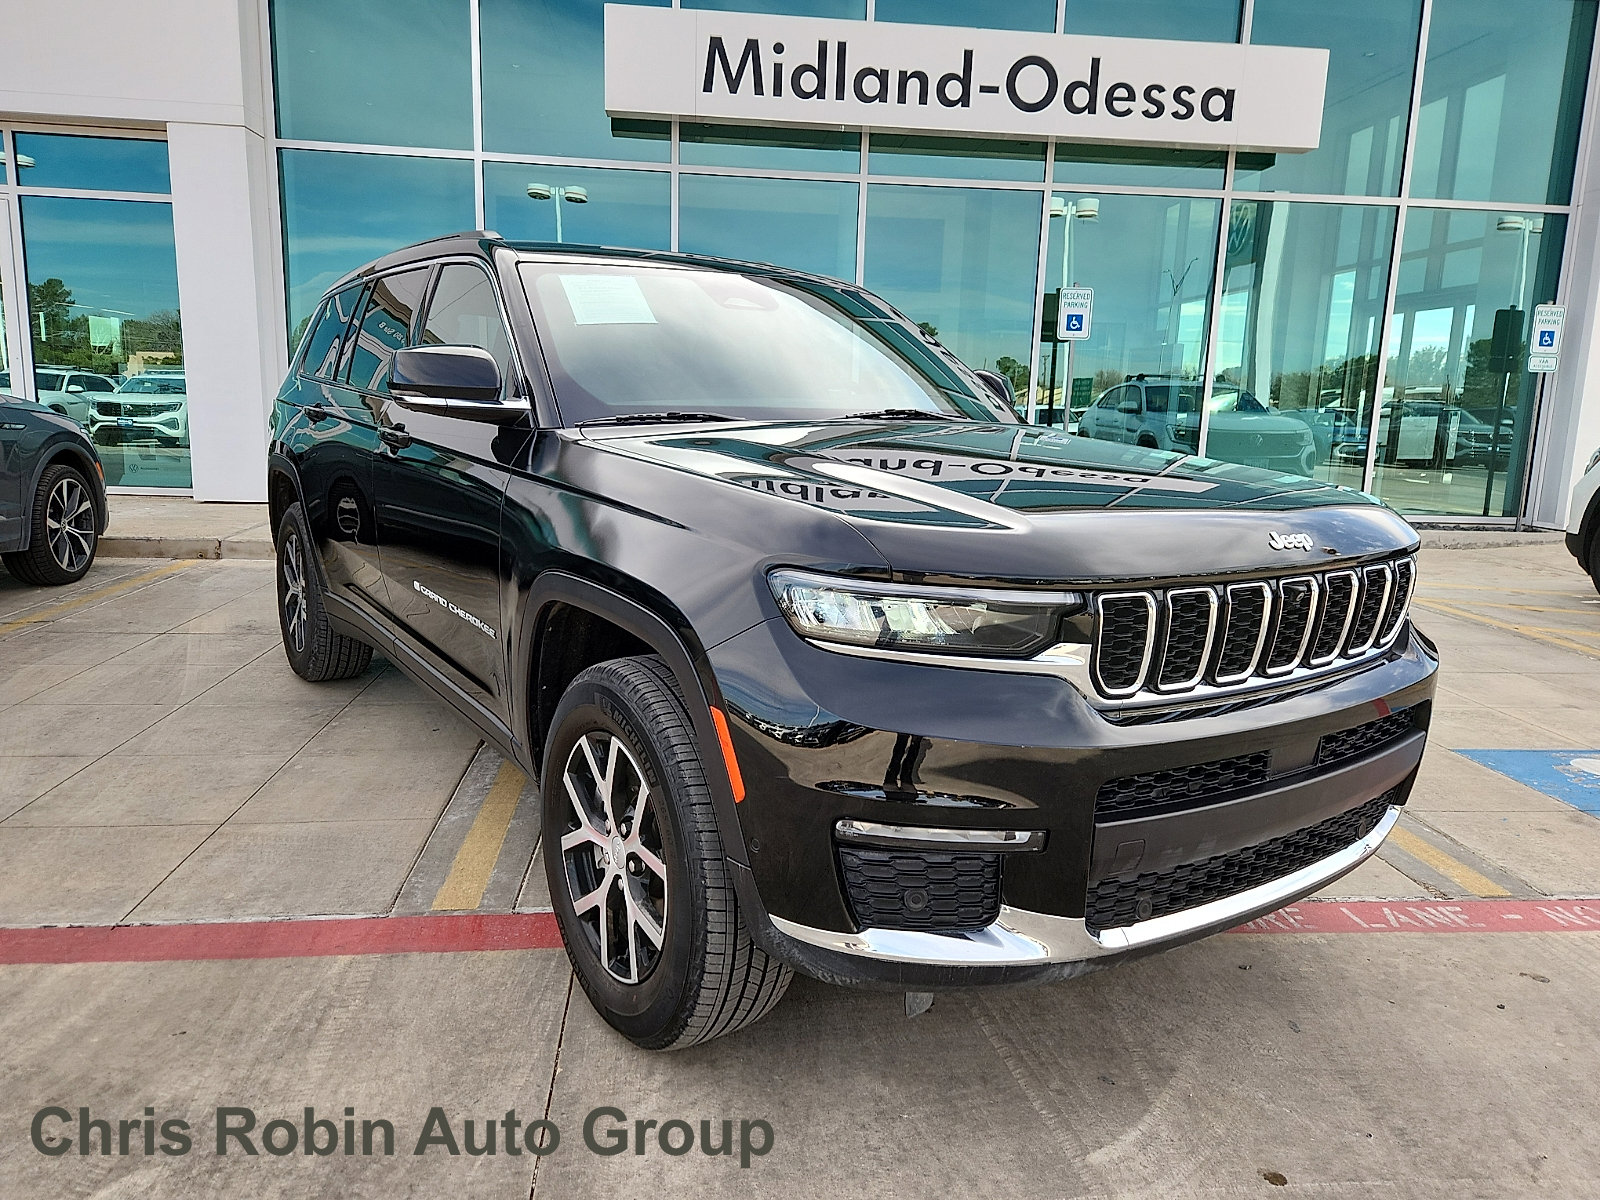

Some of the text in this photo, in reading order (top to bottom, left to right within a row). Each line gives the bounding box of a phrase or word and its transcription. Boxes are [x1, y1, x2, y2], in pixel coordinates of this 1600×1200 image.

[702, 35, 1237, 122] Midland-Odessa
[1062, 292, 1091, 300] RESERVED
[1063, 301, 1088, 309] PARKING
[1537, 309, 1563, 318] RESERVED
[1537, 318, 1560, 326] PARKING
[1268, 530, 1314, 552] Jeep
[420, 585, 496, 640] GRAND CHEROKEE
[1339, 905, 1487, 929] LANE
